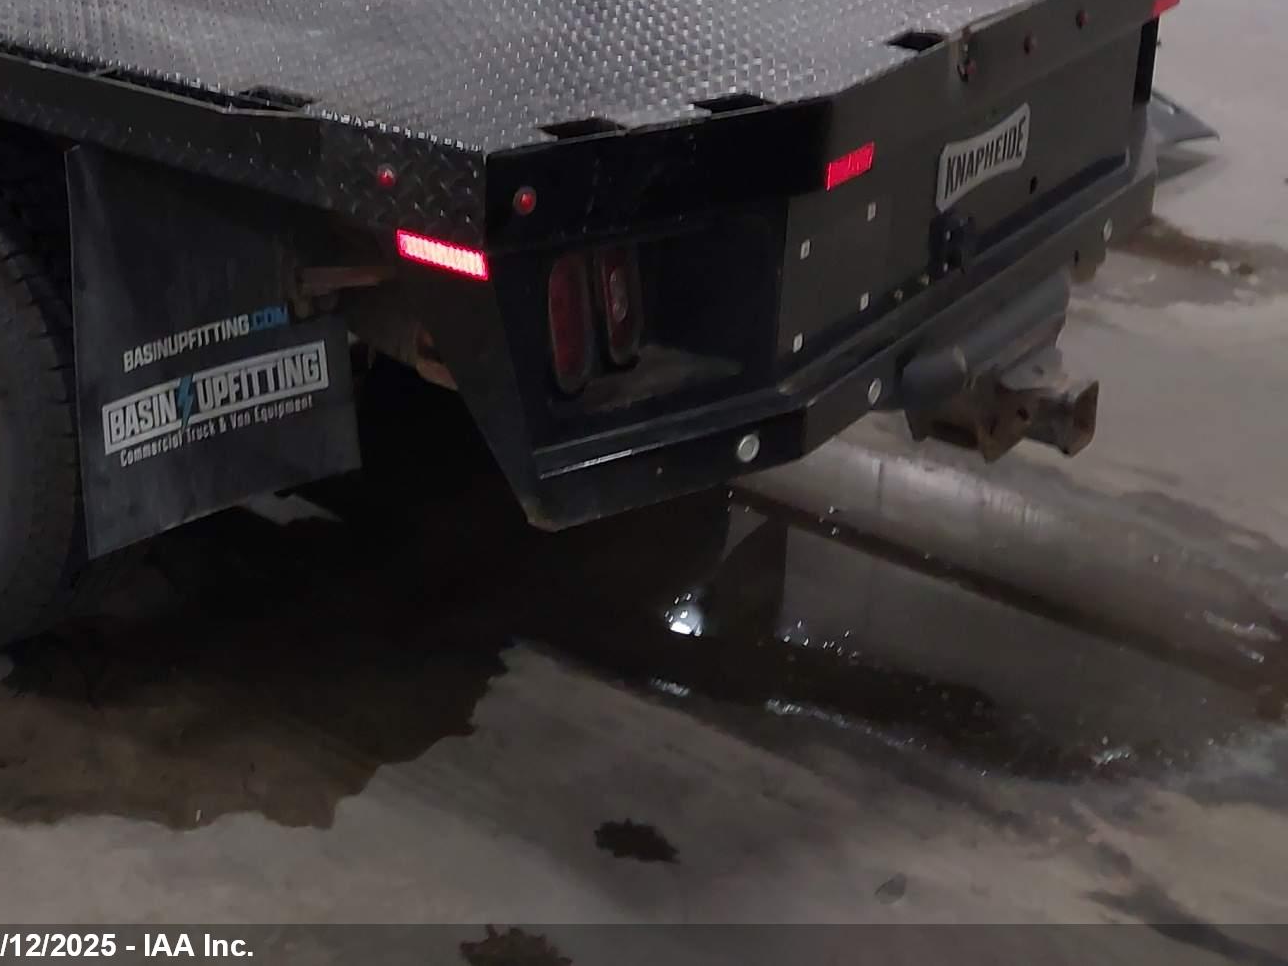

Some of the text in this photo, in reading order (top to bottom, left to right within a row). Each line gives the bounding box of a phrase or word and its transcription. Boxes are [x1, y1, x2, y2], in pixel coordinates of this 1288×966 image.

[944, 114, 1027, 201] KNAPHEIDE
[123, 304, 288, 374] BASINUPFITTING.COM
[110, 352, 321, 445] BASIN UPFITTING
[119, 429, 184, 468] Commercial
[186, 420, 216, 443] Truck
[230, 411, 252, 431] Van
[254, 394, 314, 425] Equipment
